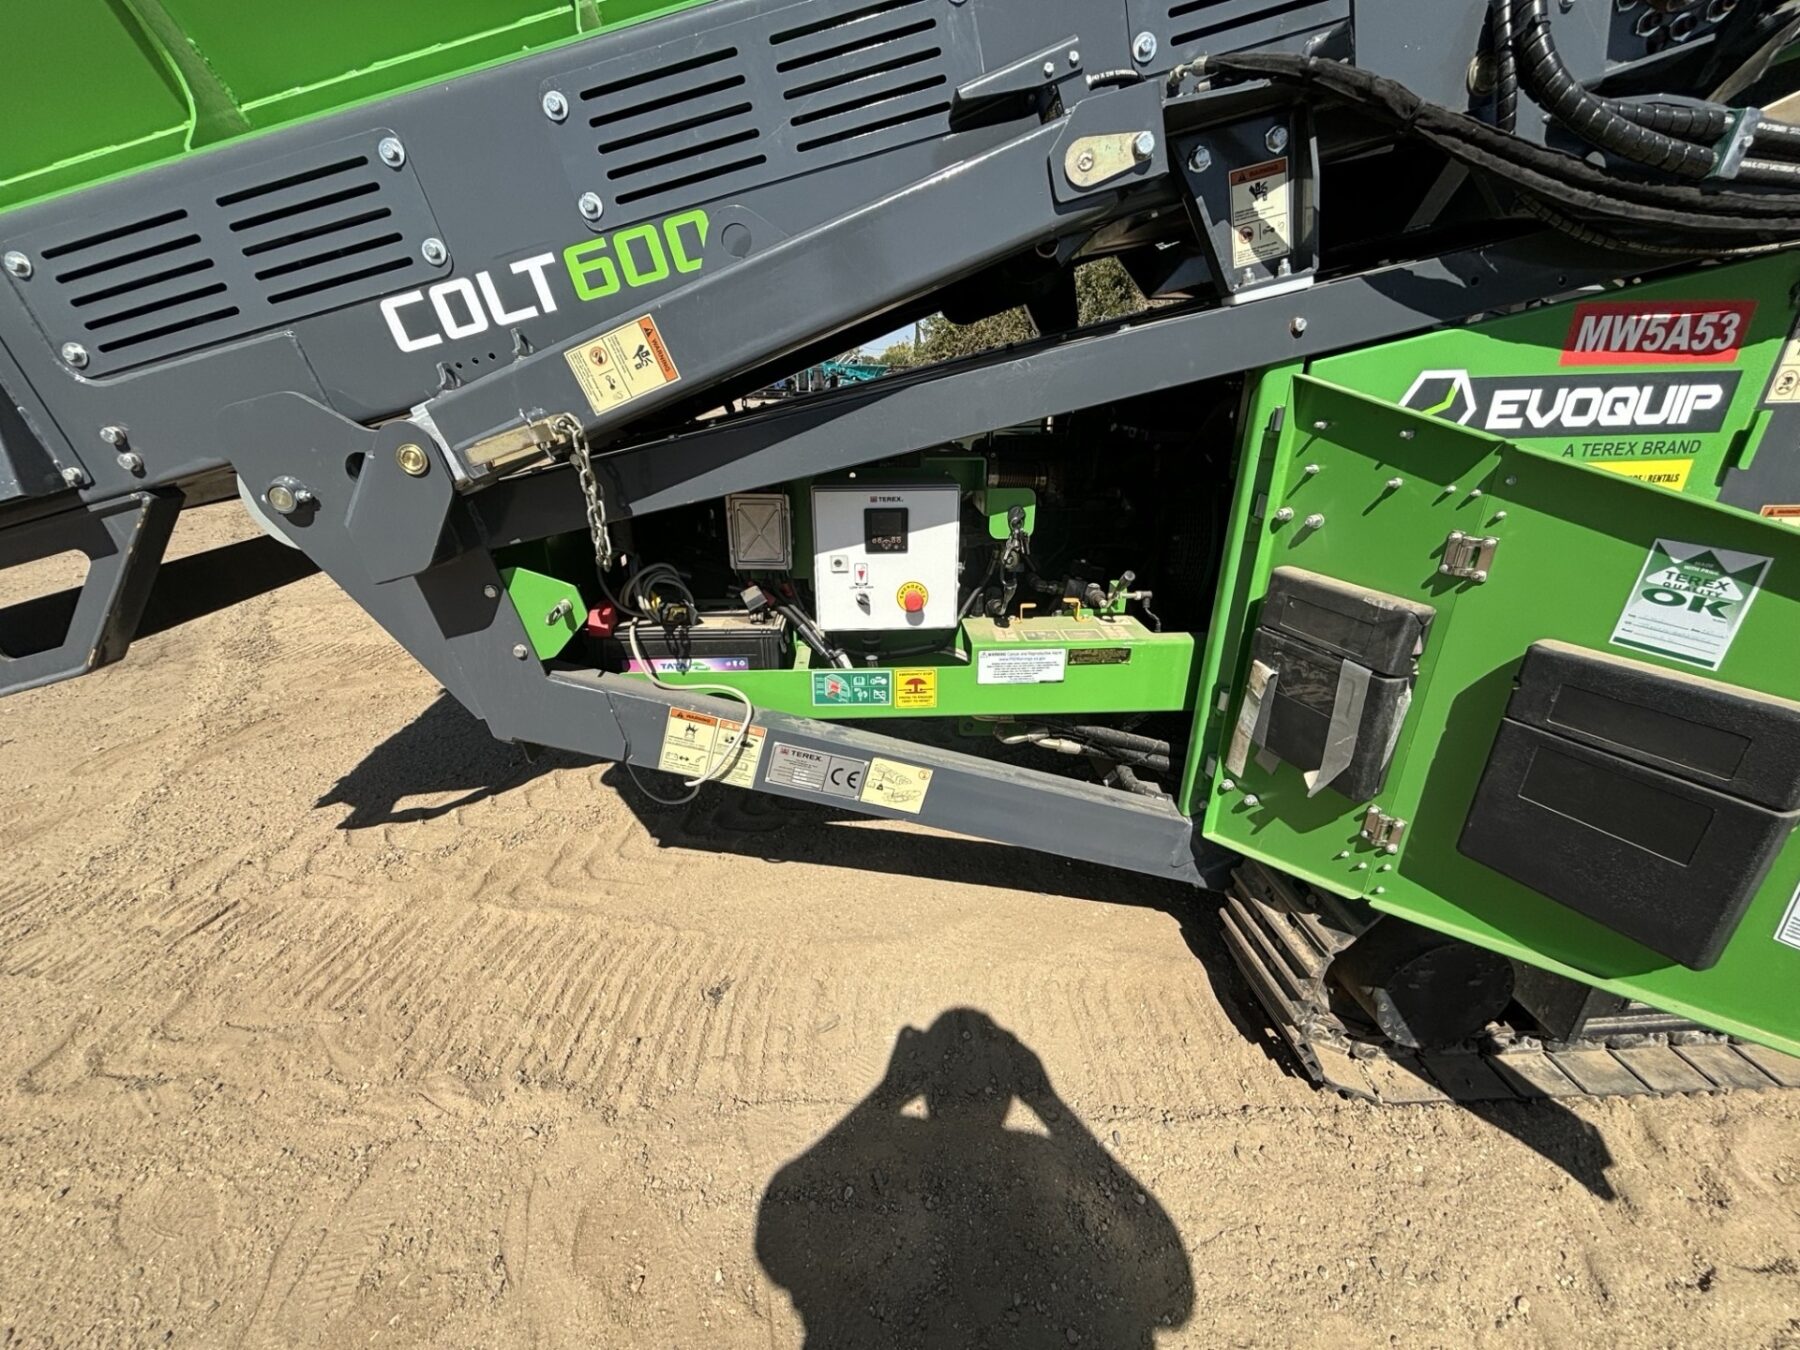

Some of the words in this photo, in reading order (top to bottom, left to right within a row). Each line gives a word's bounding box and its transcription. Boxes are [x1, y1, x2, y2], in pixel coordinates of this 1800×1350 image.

[1574, 312, 1740, 352] MW5A53
[651, 338, 671, 373] WARNING
[1484, 383, 1724, 430] EVOQUIP
[1561, 443, 1575, 458] A
[1581, 441, 1638, 458] TEREX
[1640, 439, 1702, 455] BRAND
[1646, 473, 1681, 484] RENTALS
[1662, 581, 1723, 599] QUALITY
[1664, 570, 1730, 592] TEREX
[1642, 588, 1733, 619] OK
[790, 749, 822, 762] TEREX
